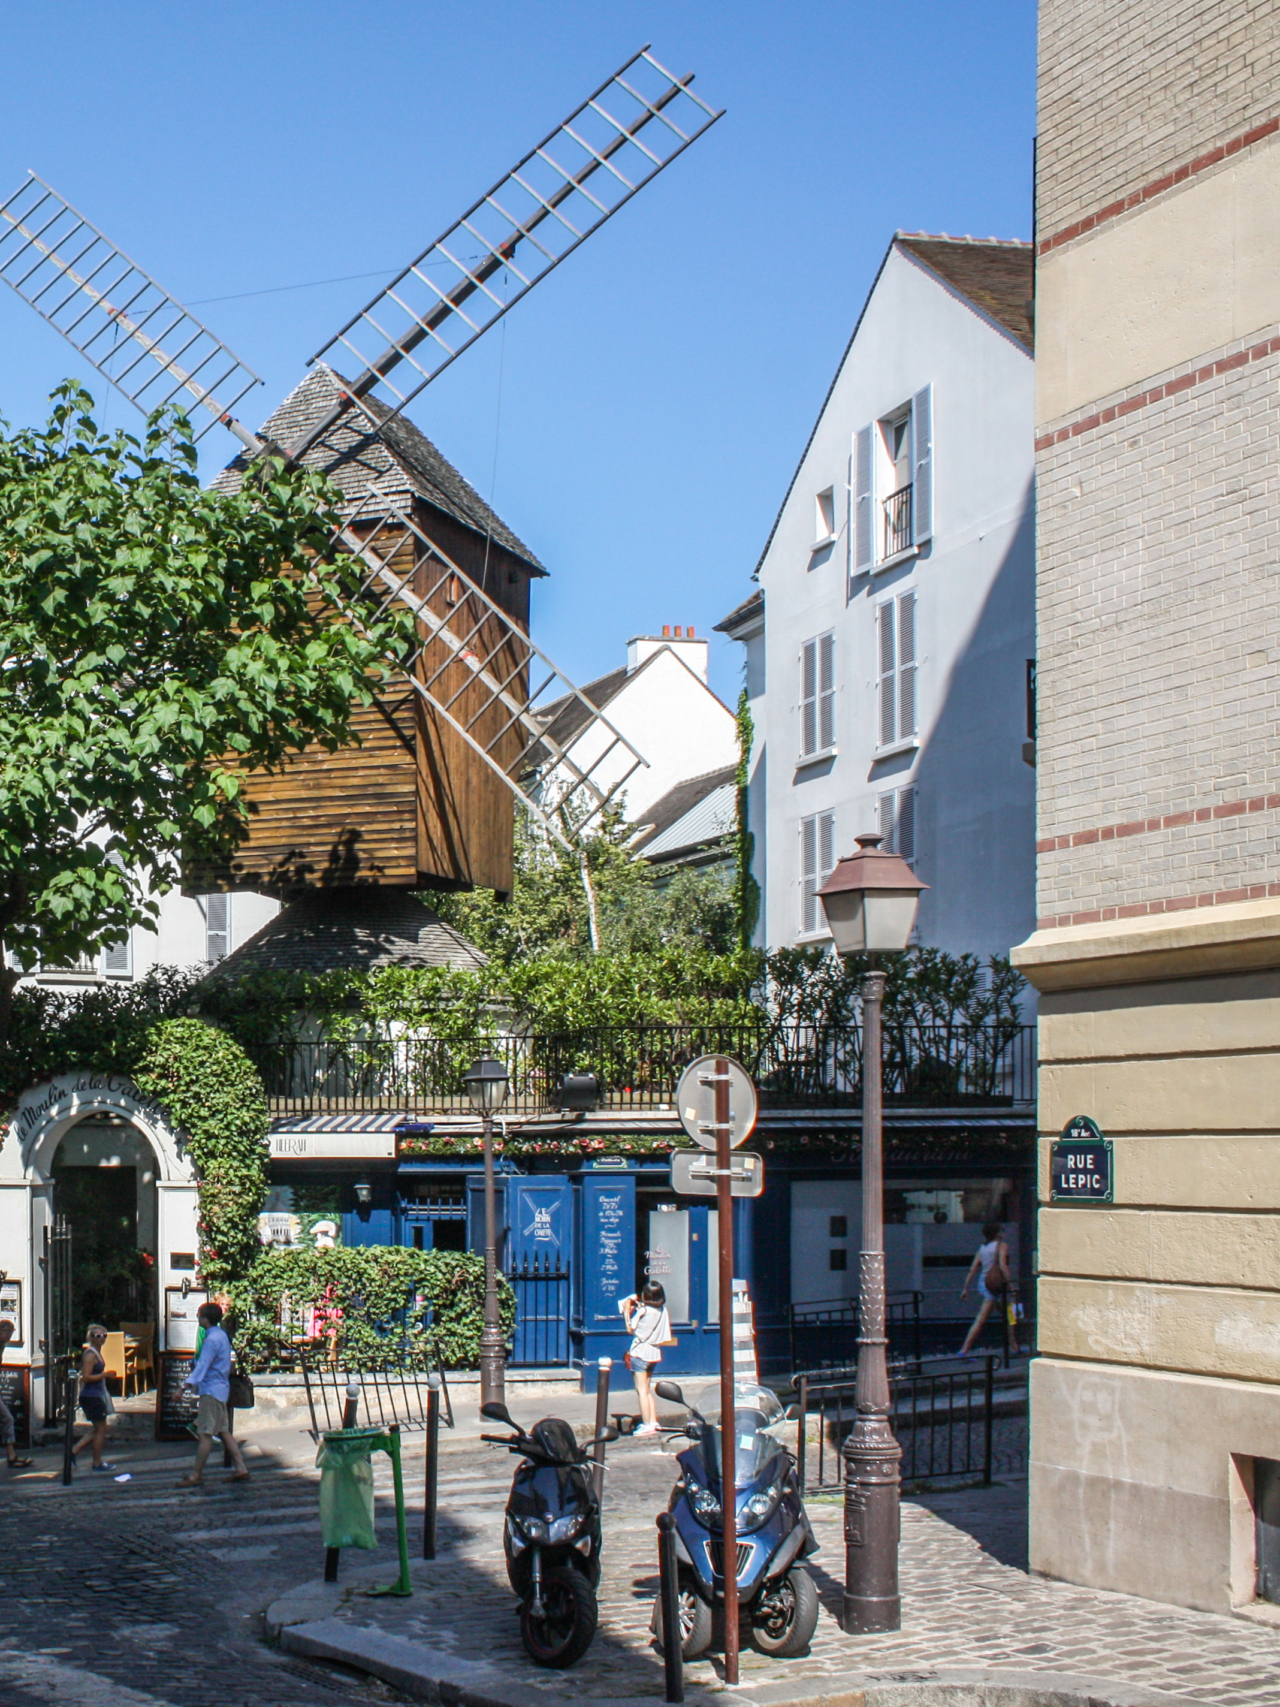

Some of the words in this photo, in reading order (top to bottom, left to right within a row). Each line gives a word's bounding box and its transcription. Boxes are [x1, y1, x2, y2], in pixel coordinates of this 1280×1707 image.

[21, 1084, 68, 1129] Moulin
[72, 1075, 87, 1093] de
[88, 1074, 103, 1090] la
[1067, 1154, 1095, 1169] RUE
[1061, 1173, 1101, 1189] LEPIC
[644, 1265, 672, 1275] Galette
